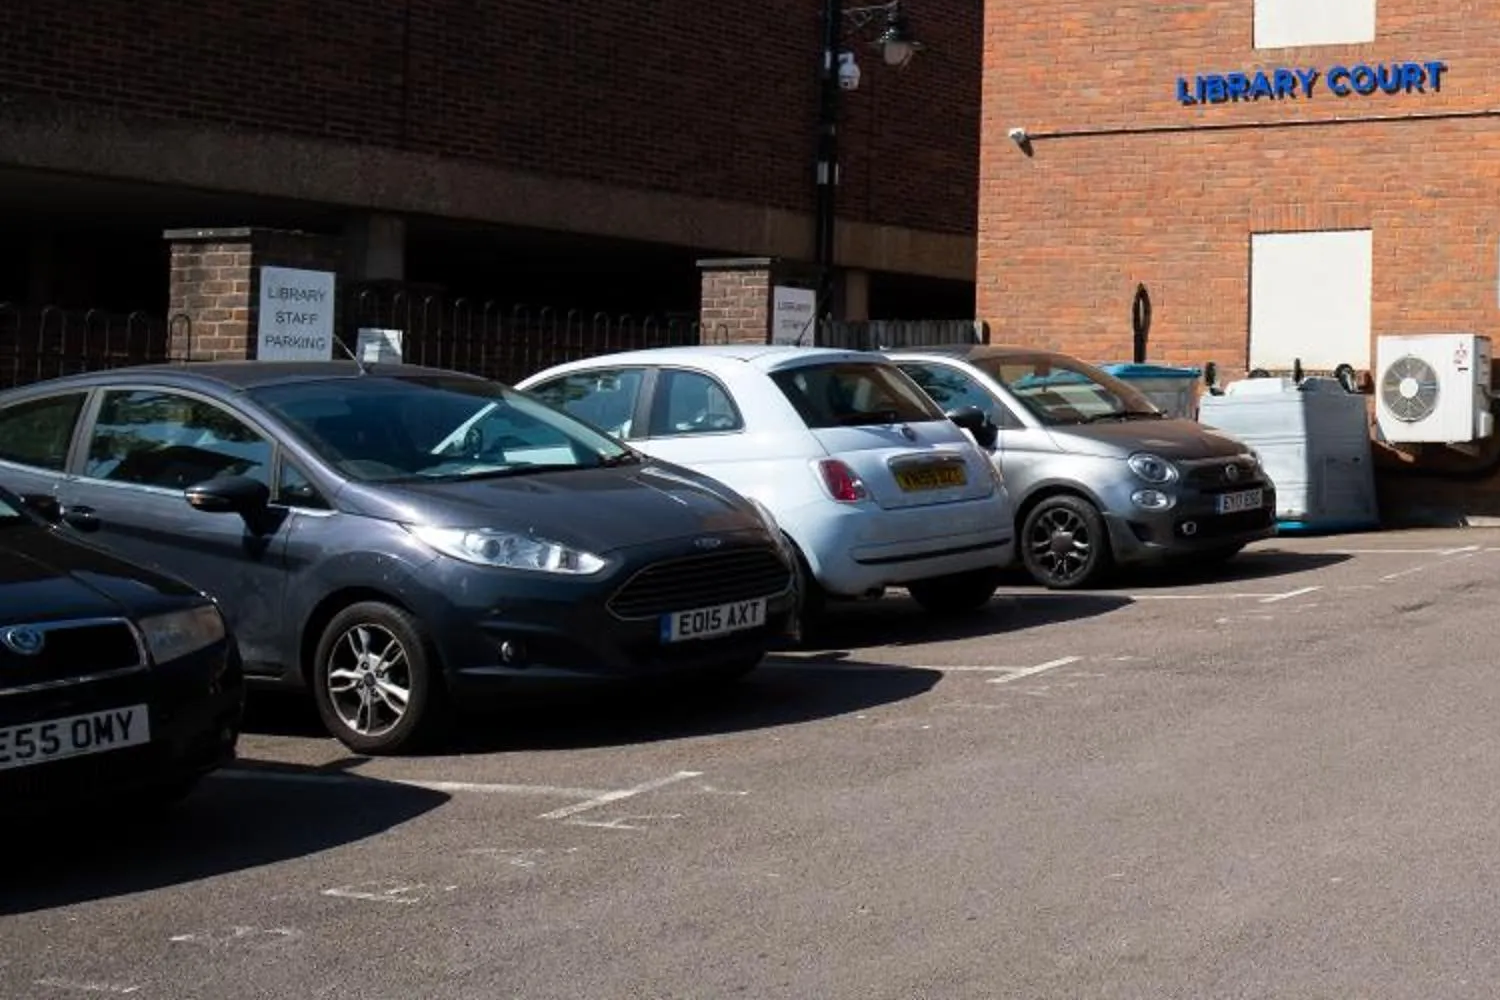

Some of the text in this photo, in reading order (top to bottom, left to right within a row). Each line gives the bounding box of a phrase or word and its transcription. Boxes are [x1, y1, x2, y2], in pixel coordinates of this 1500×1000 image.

[1176, 61, 1447, 105] LIBRARY COURT
[267, 287, 327, 302] LIBRARY
[275, 311, 319, 325] STAFF
[265, 335, 326, 350] PARKING
[727, 601, 761, 626] AXT
